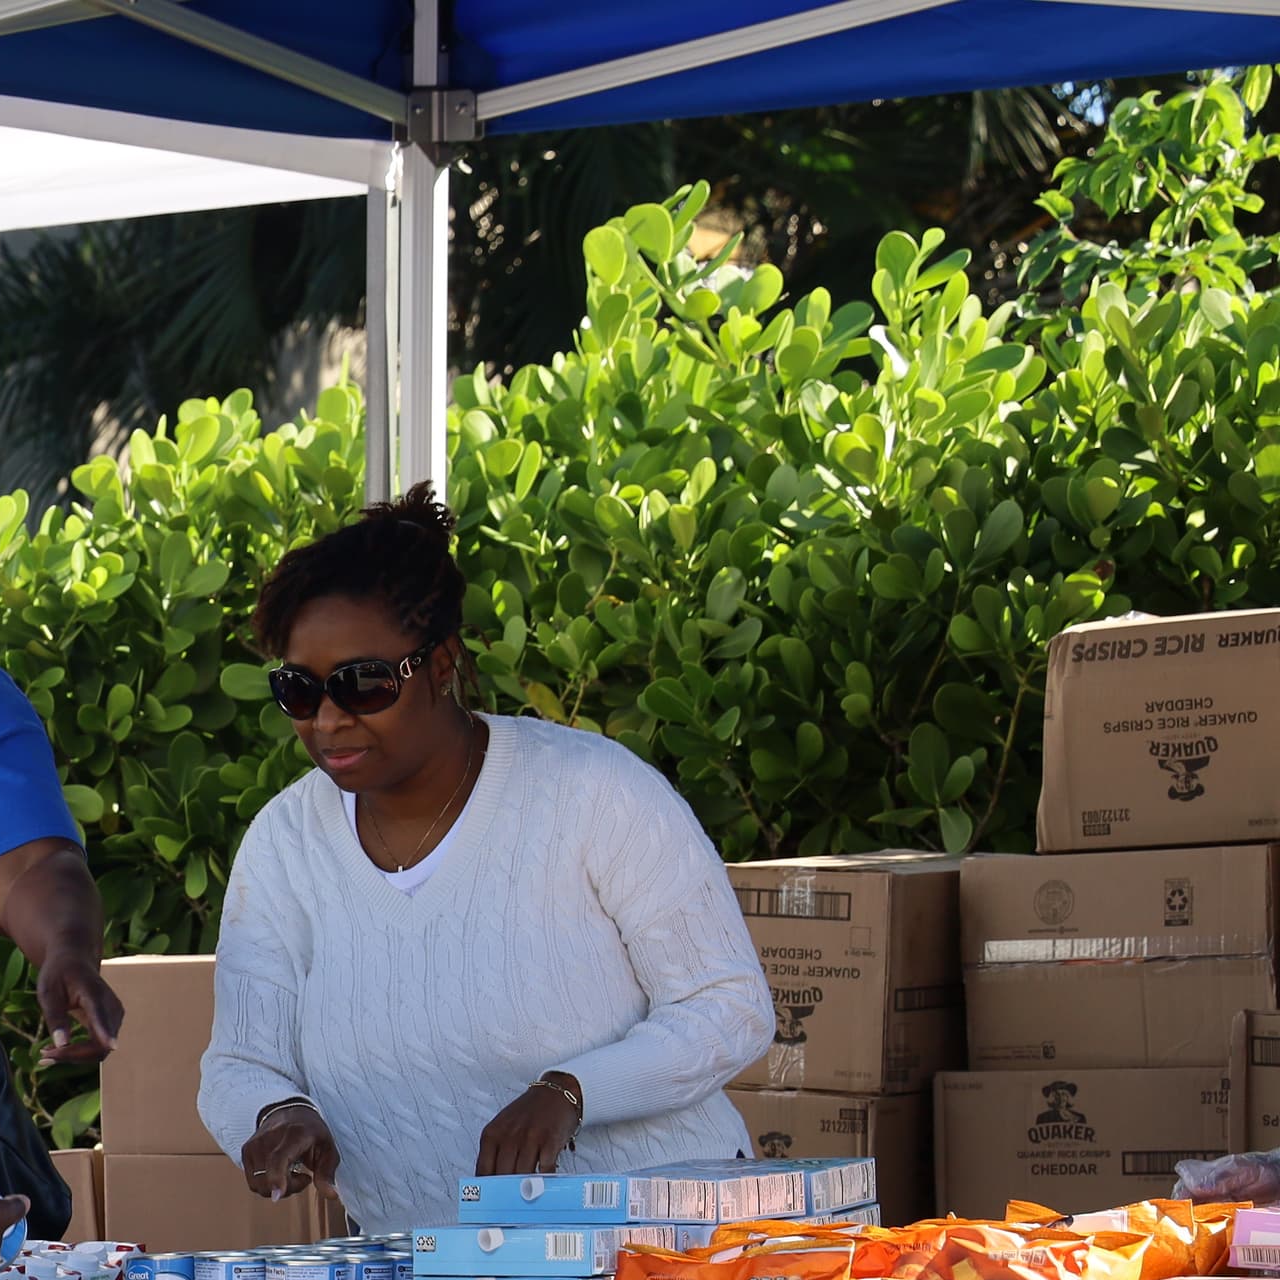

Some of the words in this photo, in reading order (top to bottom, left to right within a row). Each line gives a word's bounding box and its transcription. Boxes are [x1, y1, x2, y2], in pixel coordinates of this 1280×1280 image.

[1071, 637, 1148, 663] CRISPS
[1153, 632, 1206, 657] RICE
[1145, 697, 1213, 713] CHEDDAR
[1103, 719, 1153, 734] CRISPS
[1158, 716, 1190, 730] RICE
[1148, 736, 1218, 758] QUAKER
[761, 946, 822, 960] CHEDDAR
[770, 963, 799, 977] RICE
[771, 986, 823, 1004] QUAKE
[1027, 1123, 1097, 1144] QUAKER
[1057, 1149, 1077, 1159] RICE
[1079, 1149, 1111, 1159] CRISPS
[1030, 1163, 1098, 1176] CHEDDAR
[128, 1271, 149, 1280] Great
